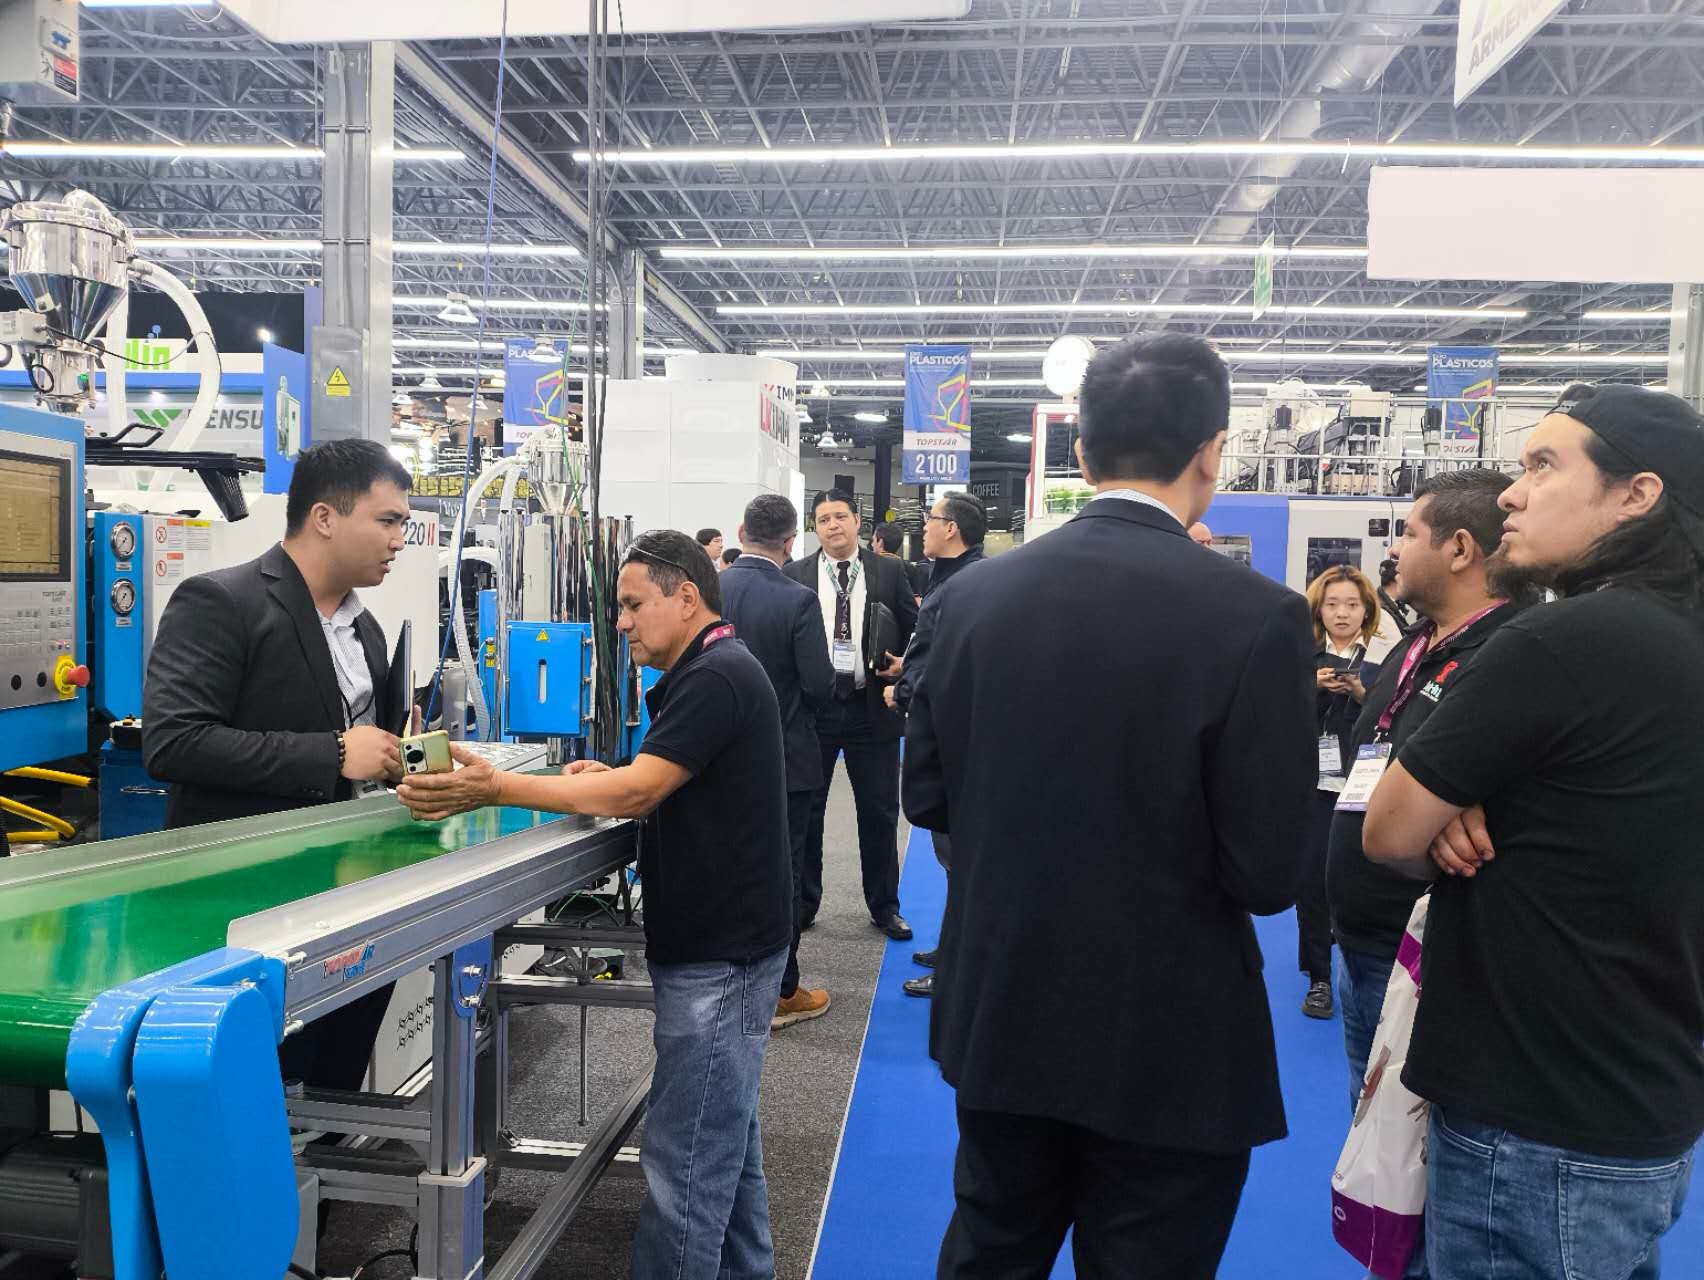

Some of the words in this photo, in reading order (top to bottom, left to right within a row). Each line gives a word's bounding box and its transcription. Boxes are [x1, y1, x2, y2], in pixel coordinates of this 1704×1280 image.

[1432, 358, 1494, 368] PLASTICOS
[187, 409, 263, 429] ENSU
[915, 453, 958, 475] 2100
[972, 483, 1001, 497] COFFEE
